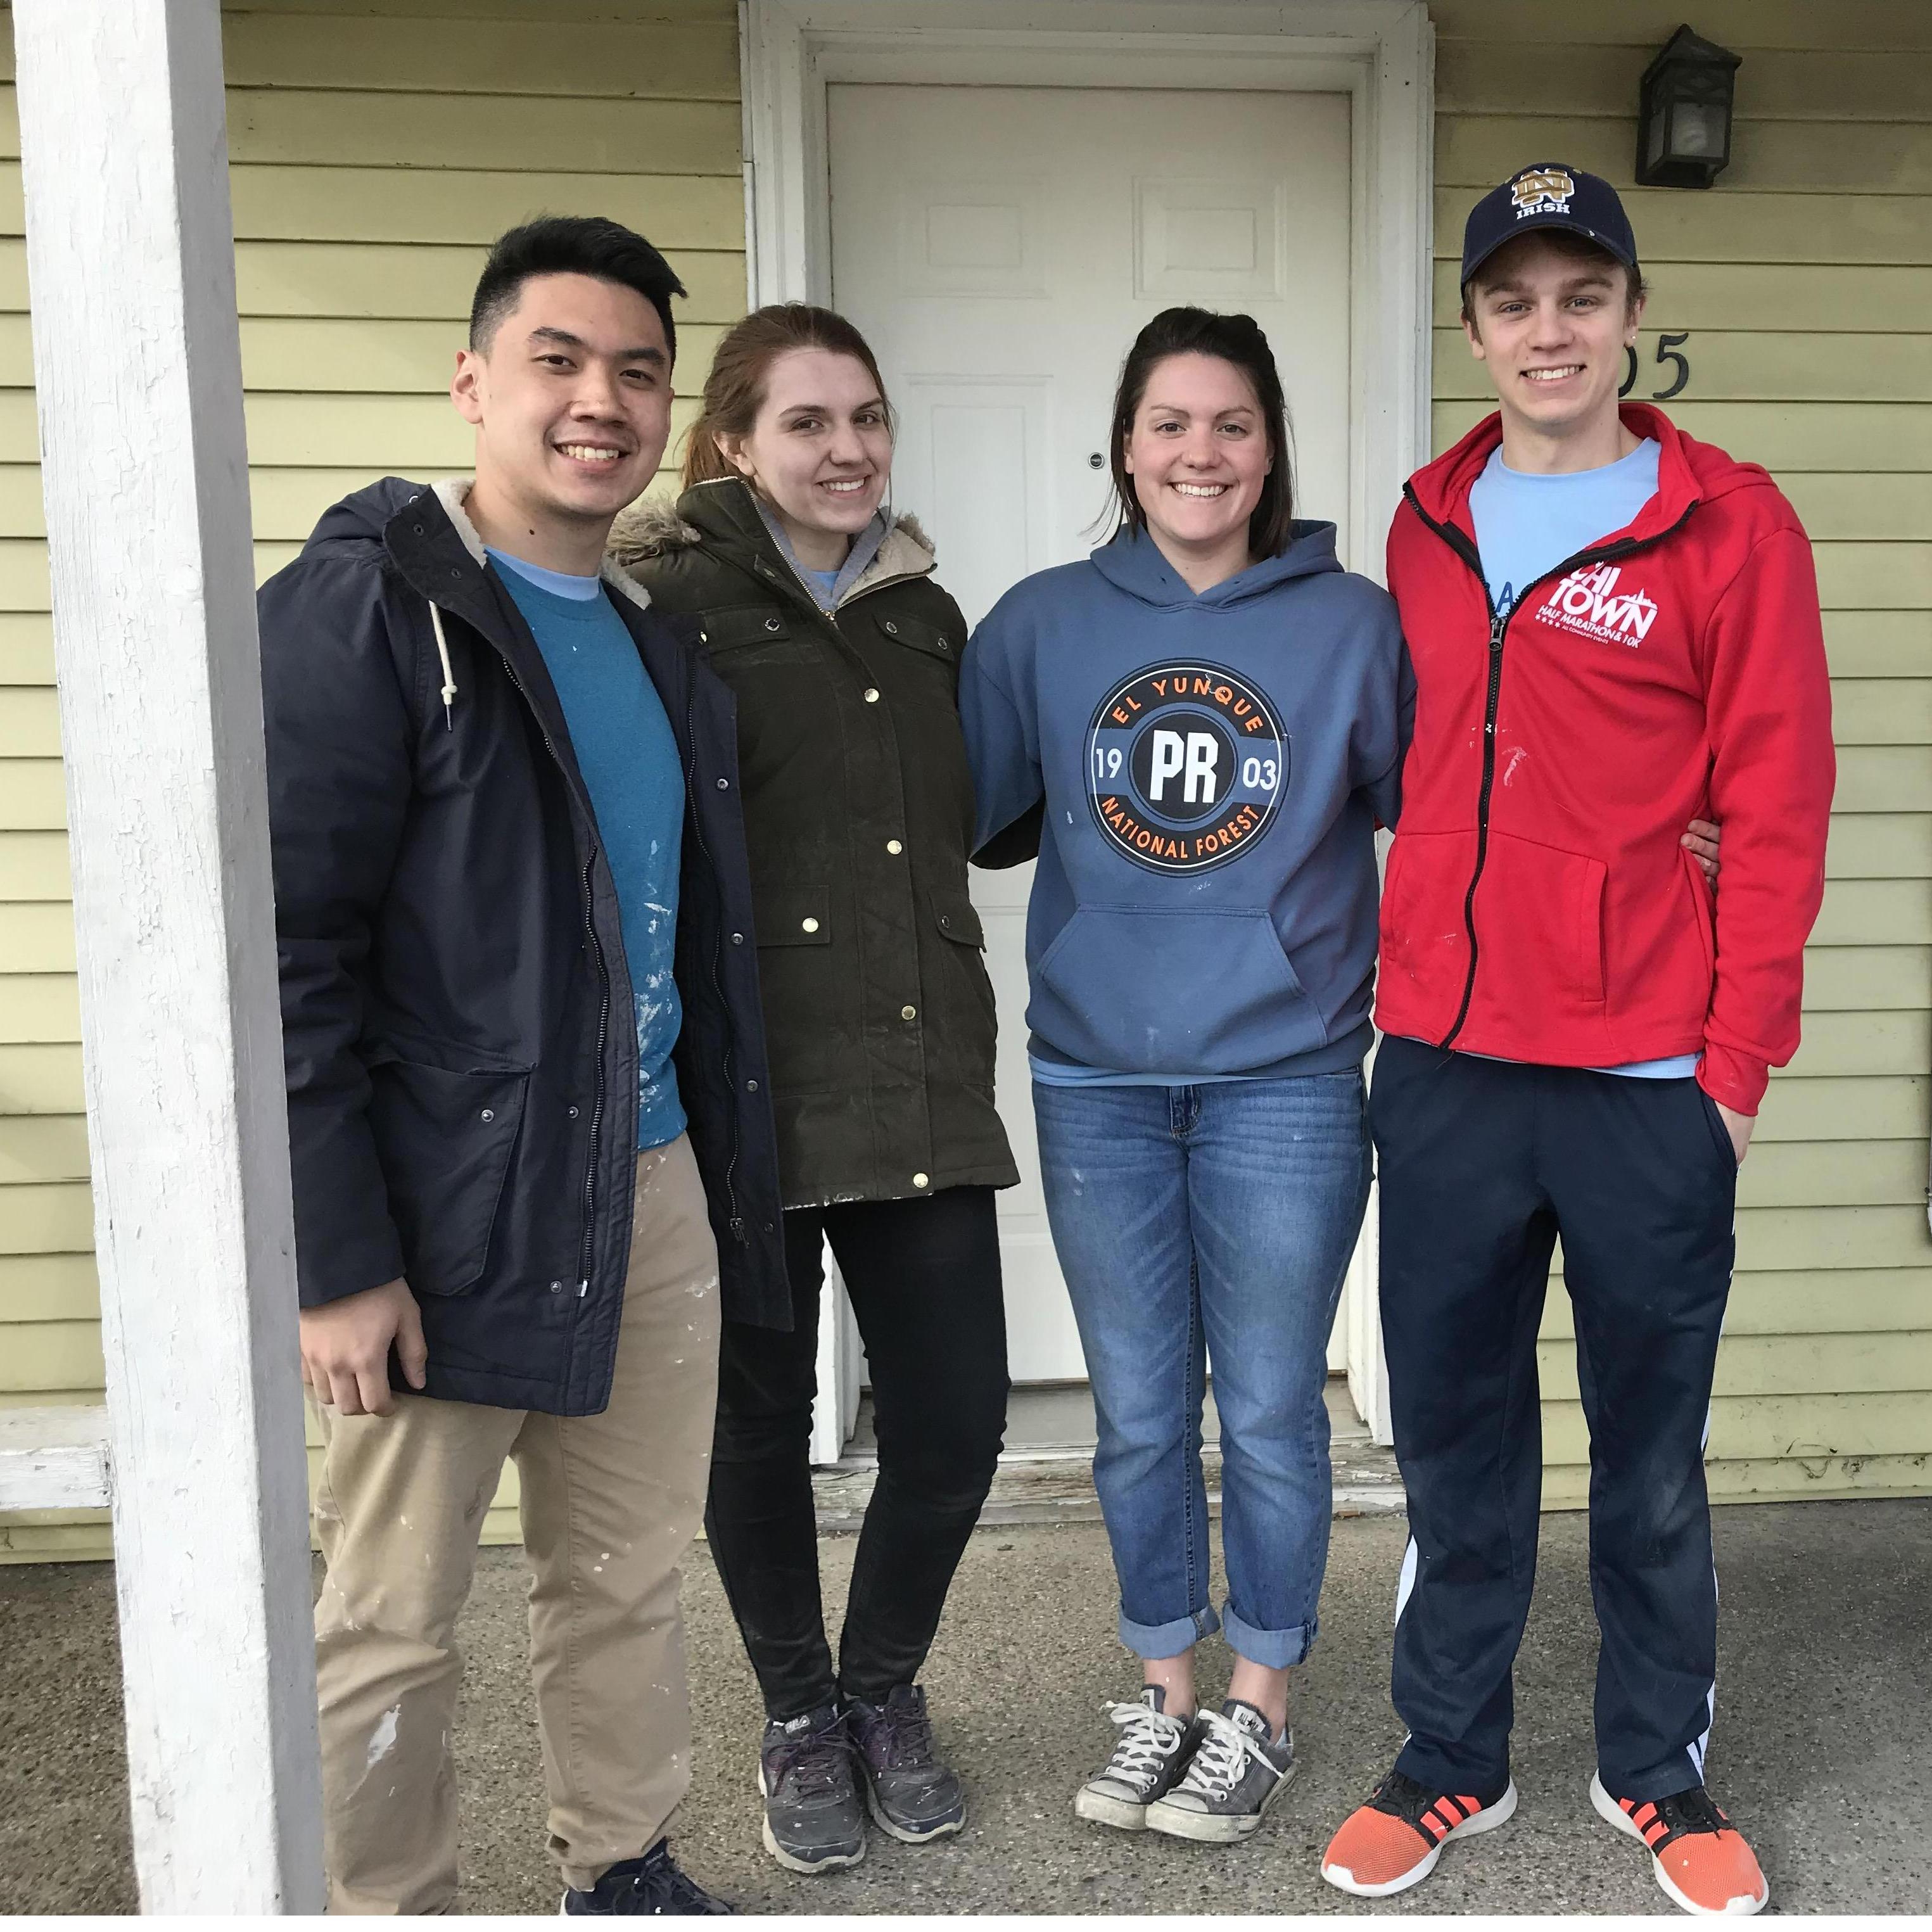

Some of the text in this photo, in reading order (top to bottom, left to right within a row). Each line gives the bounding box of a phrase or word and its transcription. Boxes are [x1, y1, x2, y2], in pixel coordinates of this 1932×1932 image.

[1516, 202, 1570, 220] IRISH
[1538, 604, 1562, 620] HALF
[1622, 634, 1642, 648] 10K
[1548, 577, 1658, 640] TOWN
[1112, 677, 1264, 732] EL YUNQUE
[1150, 729, 1219, 803] PR
[1102, 796, 1259, 858] NATIONAL FOREST
